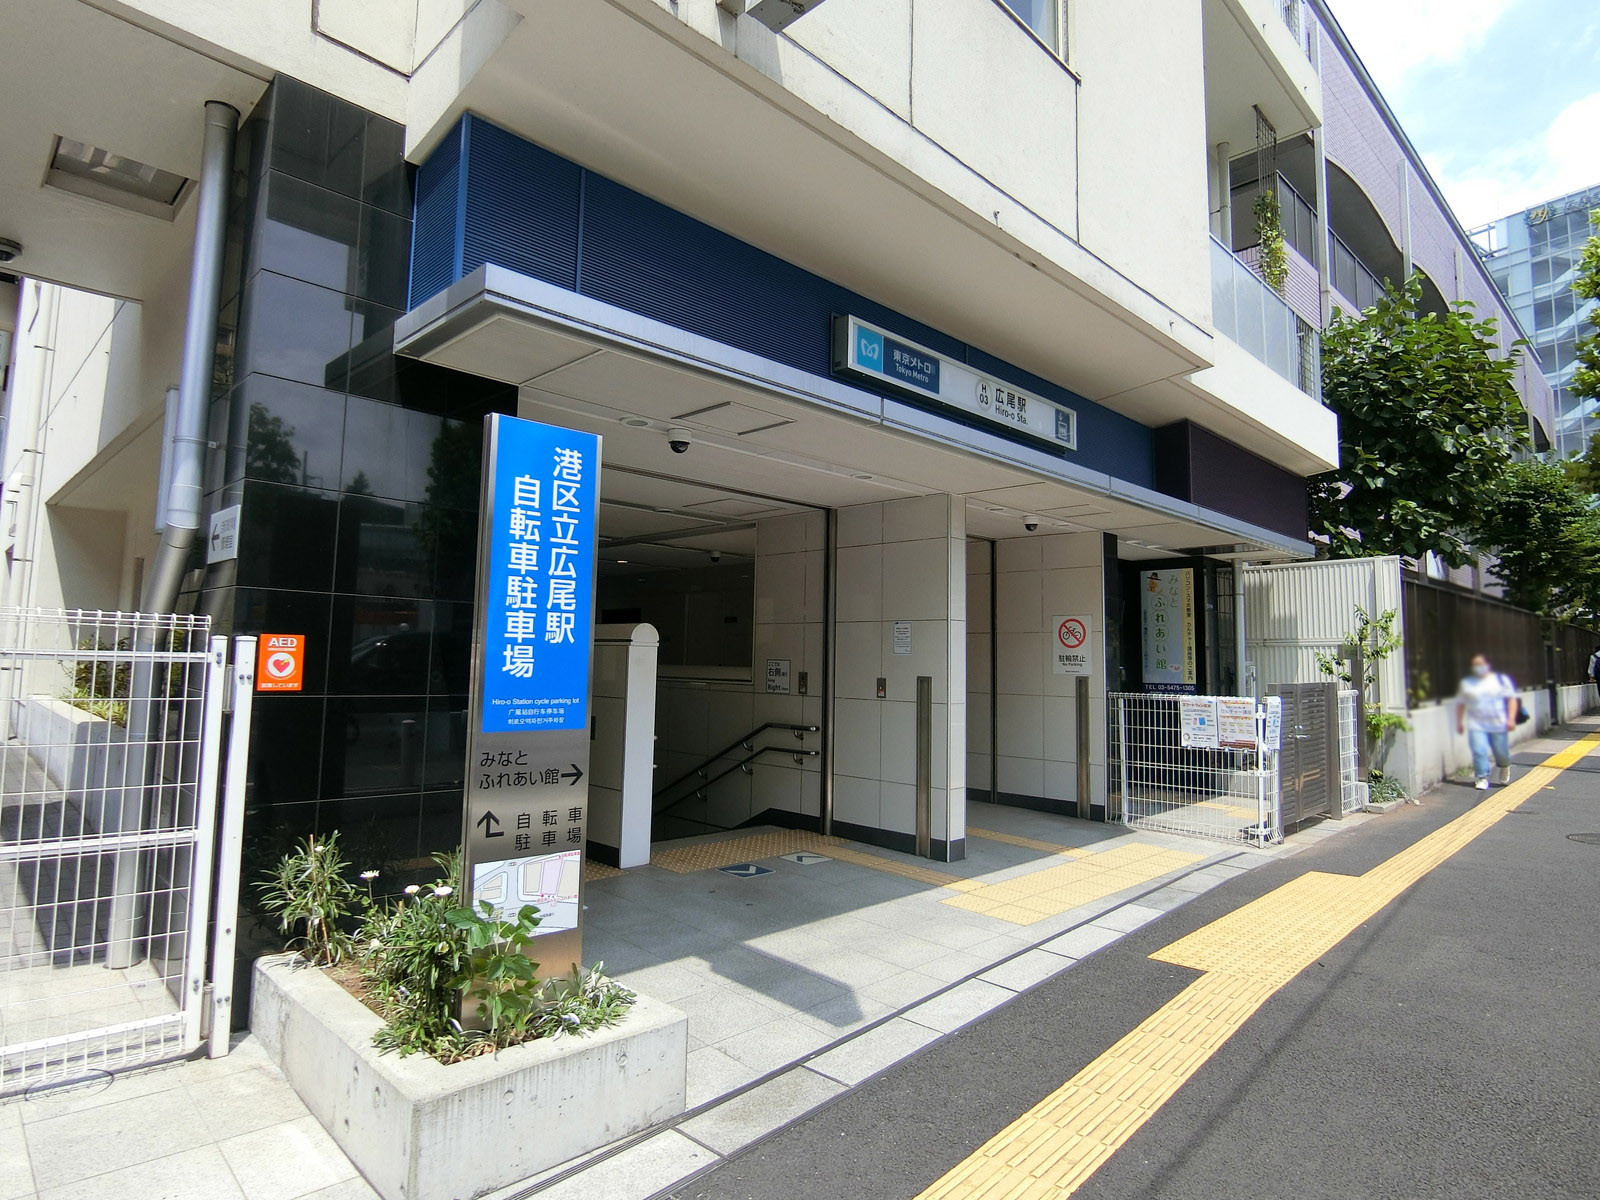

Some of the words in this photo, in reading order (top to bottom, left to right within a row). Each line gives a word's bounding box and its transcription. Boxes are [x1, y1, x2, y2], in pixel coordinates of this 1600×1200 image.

[893, 349, 931, 374] 東京メトロ
[895, 363, 912, 377] Tokyo
[912, 370, 929, 383] Metro
[979, 393, 989, 406] 03
[981, 383, 987, 394] H
[995, 387, 1027, 413] 広尾駅
[995, 404, 1016, 420] Hiro-o
[1016, 412, 1028, 425] Sta.
[544, 446, 583, 644] 港区立広尾駅
[501, 474, 542, 678] 自転車駐車場
[1168, 574, 1179, 608] みなと
[268, 637, 297, 647] AED
[1154, 597, 1167, 670] ふれあい館
[534, 698, 550, 706] cycle
[550, 698, 572, 706] parking
[480, 750, 528, 767] みなと
[479, 768, 560, 789] ふれあい館
[517, 807, 583, 830] 自転車
[514, 827, 581, 851] 駐車場
